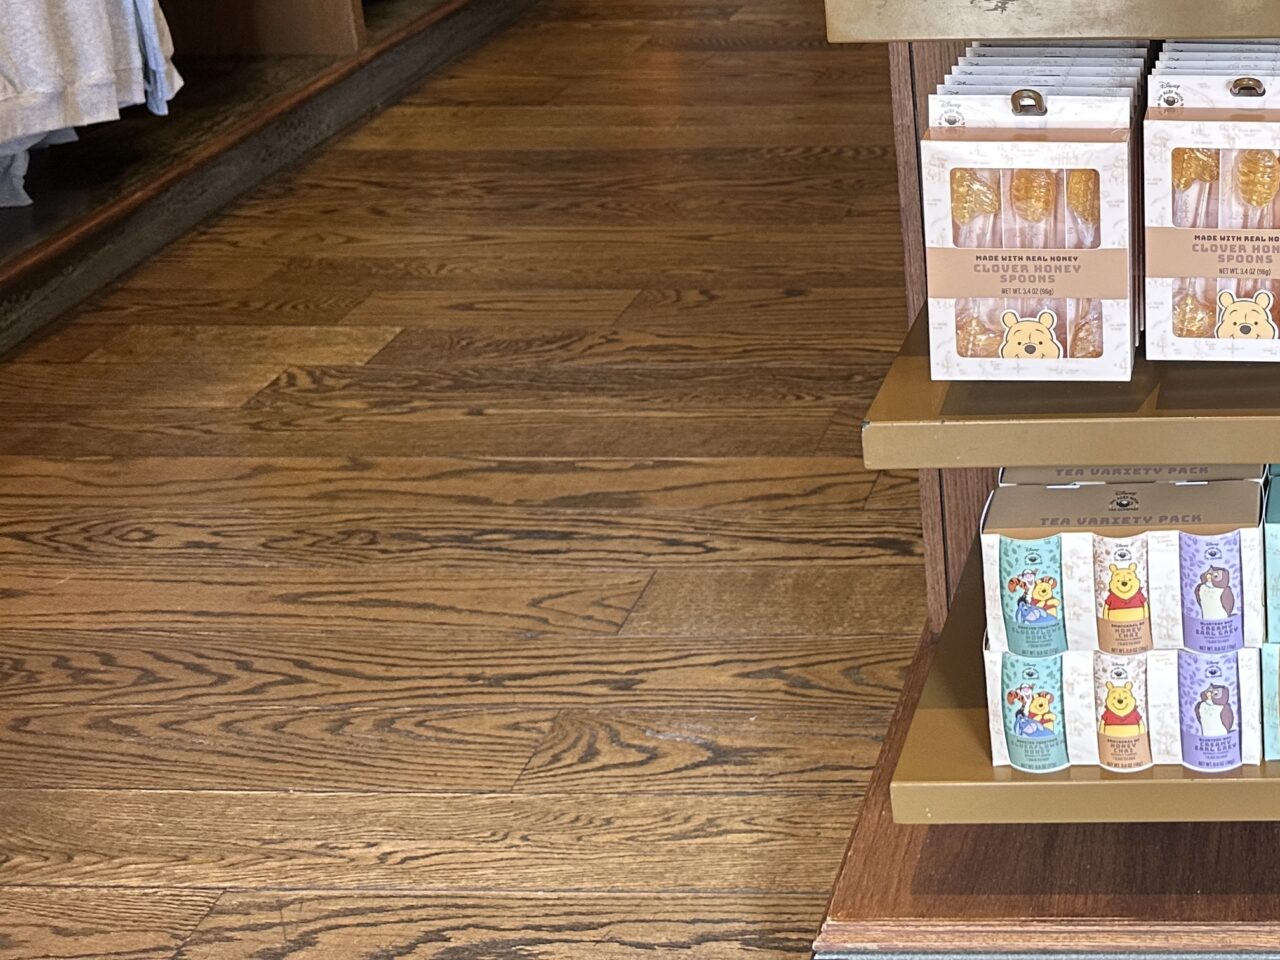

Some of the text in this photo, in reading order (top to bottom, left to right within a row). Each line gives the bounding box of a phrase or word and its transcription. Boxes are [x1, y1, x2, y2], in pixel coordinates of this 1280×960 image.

[1192, 244, 1246, 253] CLOVER
[1218, 255, 1273, 263] SPOONS
[974, 264, 1081, 273] CLOVER HONEY
[1000, 275, 1055, 283] SPOONS
[1077, 516, 1152, 525] VARIETY
[1159, 515, 1202, 523] PACK
